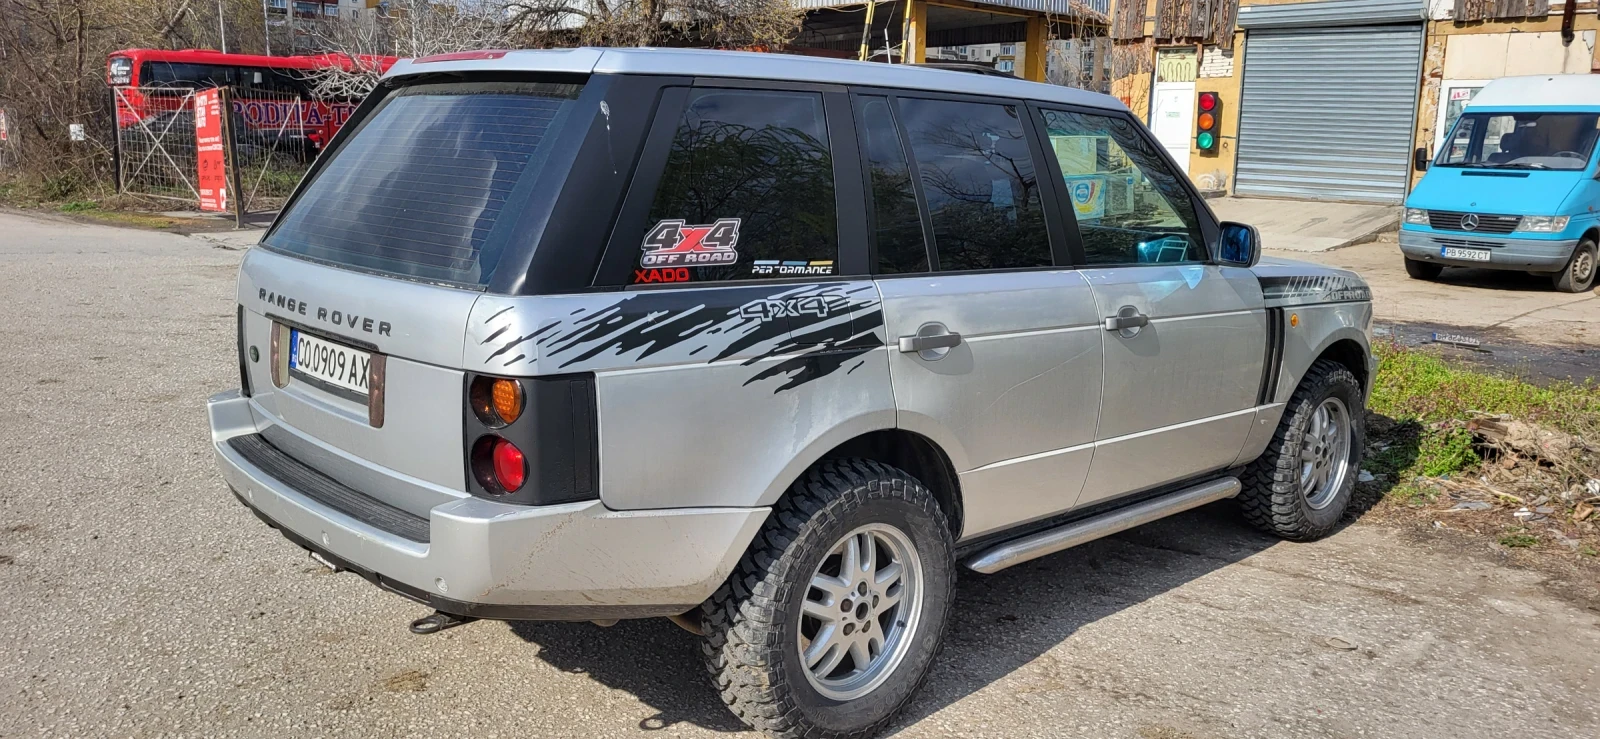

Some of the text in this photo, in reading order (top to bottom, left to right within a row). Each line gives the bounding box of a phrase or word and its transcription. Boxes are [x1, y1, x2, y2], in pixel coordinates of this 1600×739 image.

[643, 252, 735, 265] OFF ROAD
[1457, 249, 1477, 259] 9592
[634, 267, 690, 283] XADO
[259, 288, 393, 337] RANGE ROVER
[348, 354, 371, 389] AX
